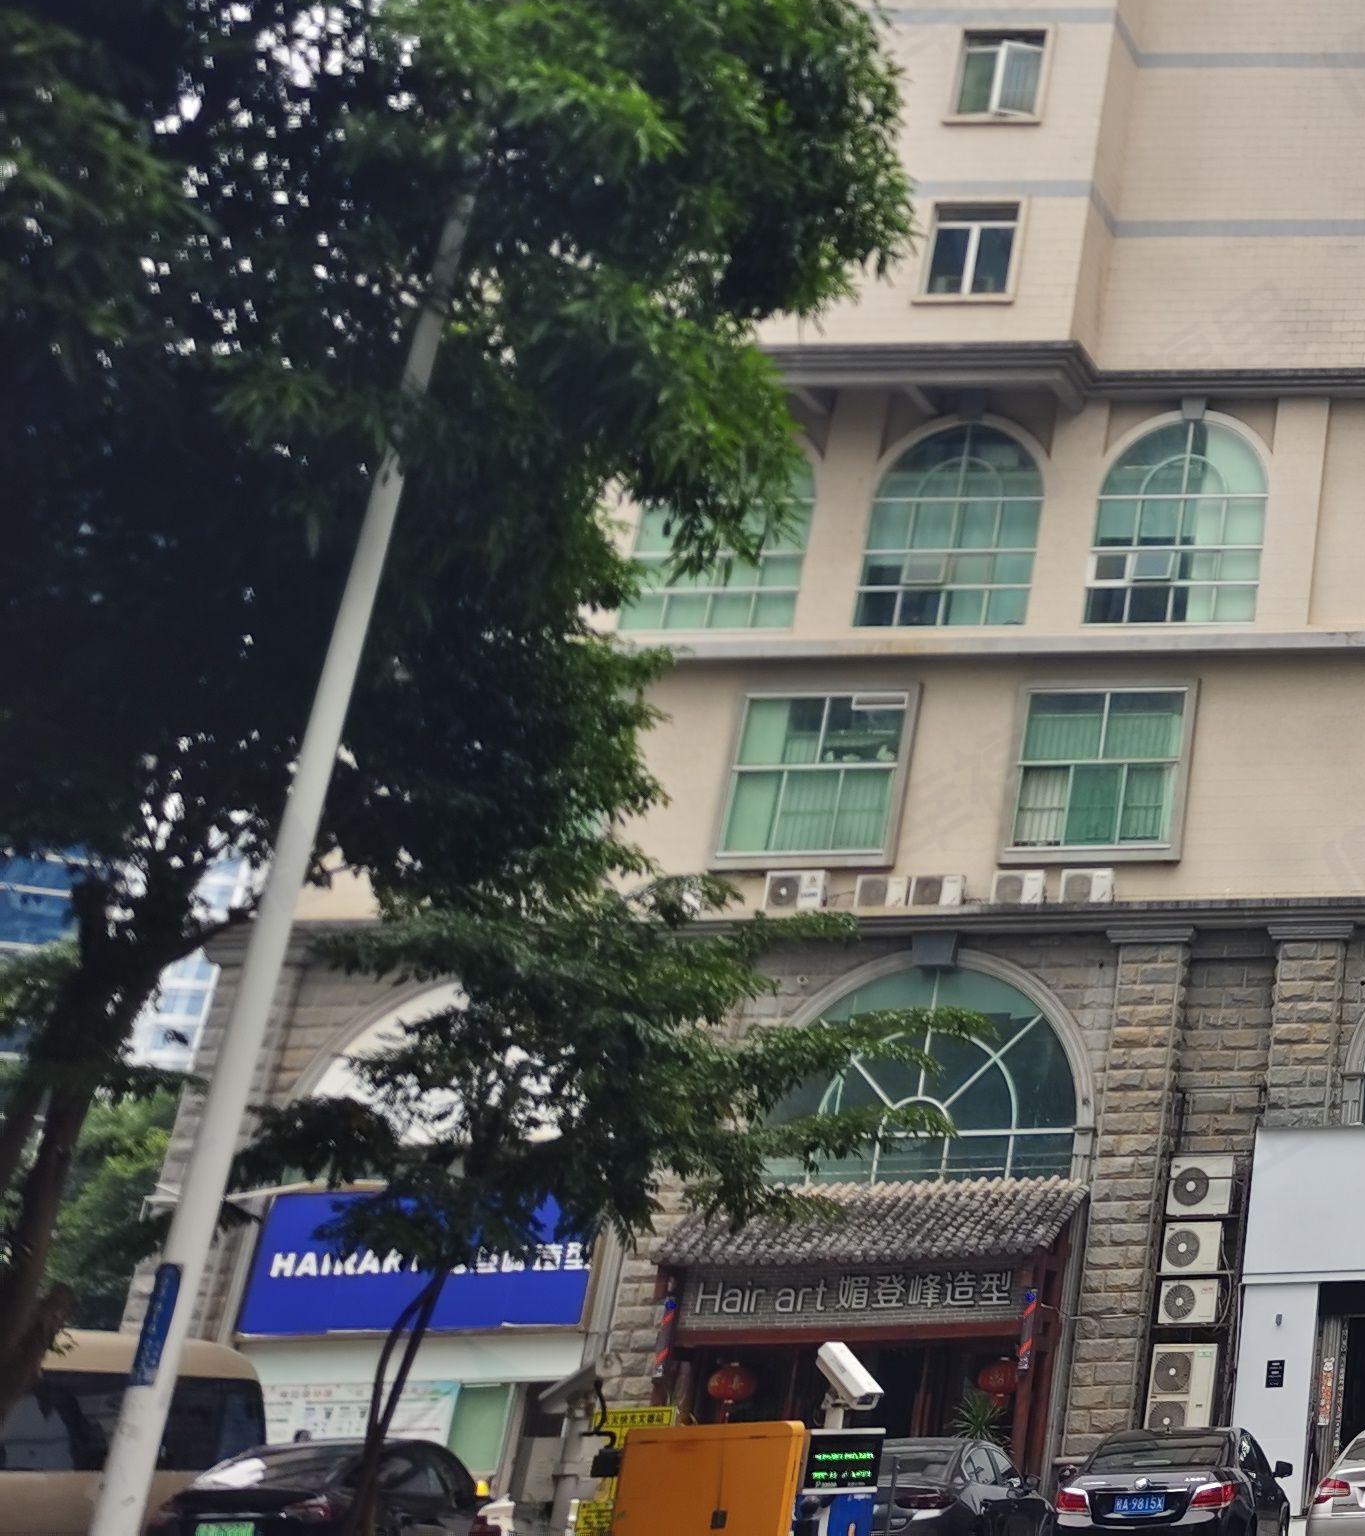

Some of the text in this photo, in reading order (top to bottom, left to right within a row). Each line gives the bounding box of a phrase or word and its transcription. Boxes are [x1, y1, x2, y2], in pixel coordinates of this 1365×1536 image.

[695, 1270, 1012, 1314] Hair art 媚登峰造型
